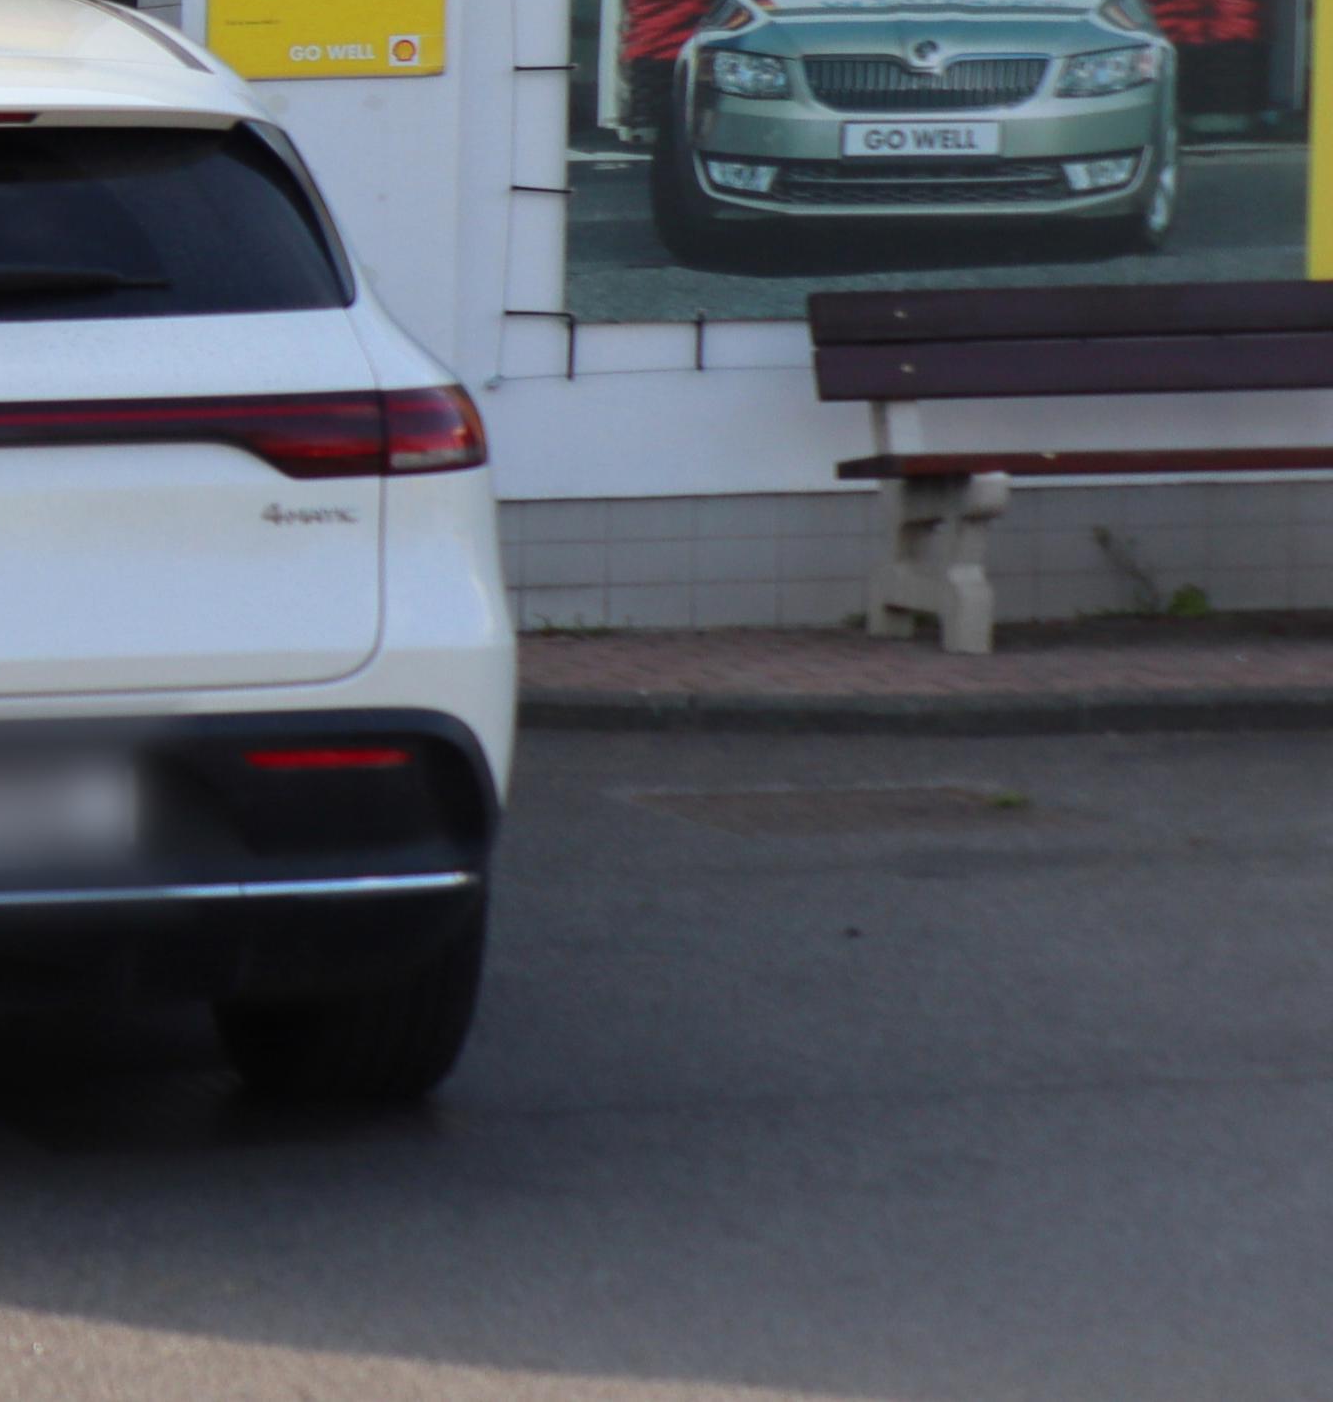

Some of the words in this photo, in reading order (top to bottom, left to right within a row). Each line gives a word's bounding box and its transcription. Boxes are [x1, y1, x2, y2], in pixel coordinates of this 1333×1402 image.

[289, 44, 321, 62] GO
[326, 44, 376, 61] WELL
[864, 128, 908, 150] GO
[912, 127, 978, 150] WELL
